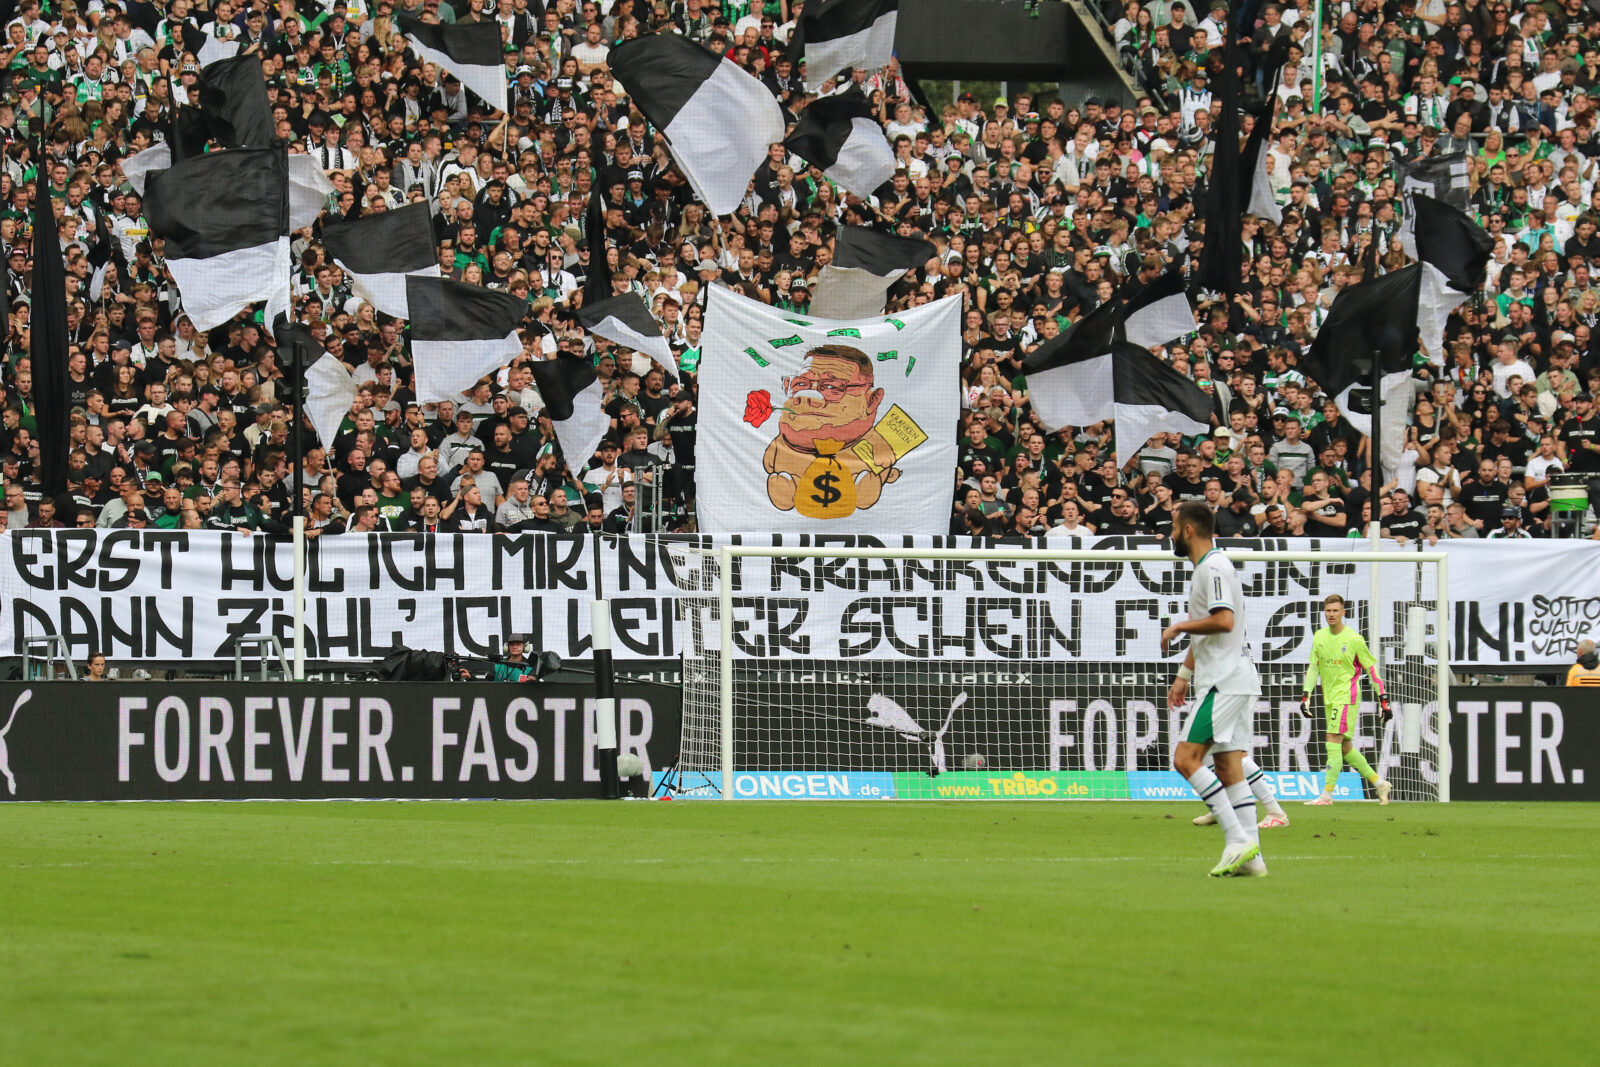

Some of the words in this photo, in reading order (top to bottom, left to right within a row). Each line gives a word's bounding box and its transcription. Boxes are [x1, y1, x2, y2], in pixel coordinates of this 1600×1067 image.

[890, 412, 919, 439] KRANKEN
[11, 529, 189, 591] ERST
[221, 532, 344, 592] HOL
[368, 533, 465, 591] ICH
[13, 596, 193, 658] DANN
[443, 596, 542, 656] ICH
[839, 596, 1081, 658] SCHEIN
[1532, 594, 1600, 620] SOTTO
[117, 695, 414, 782] FOREVER.
